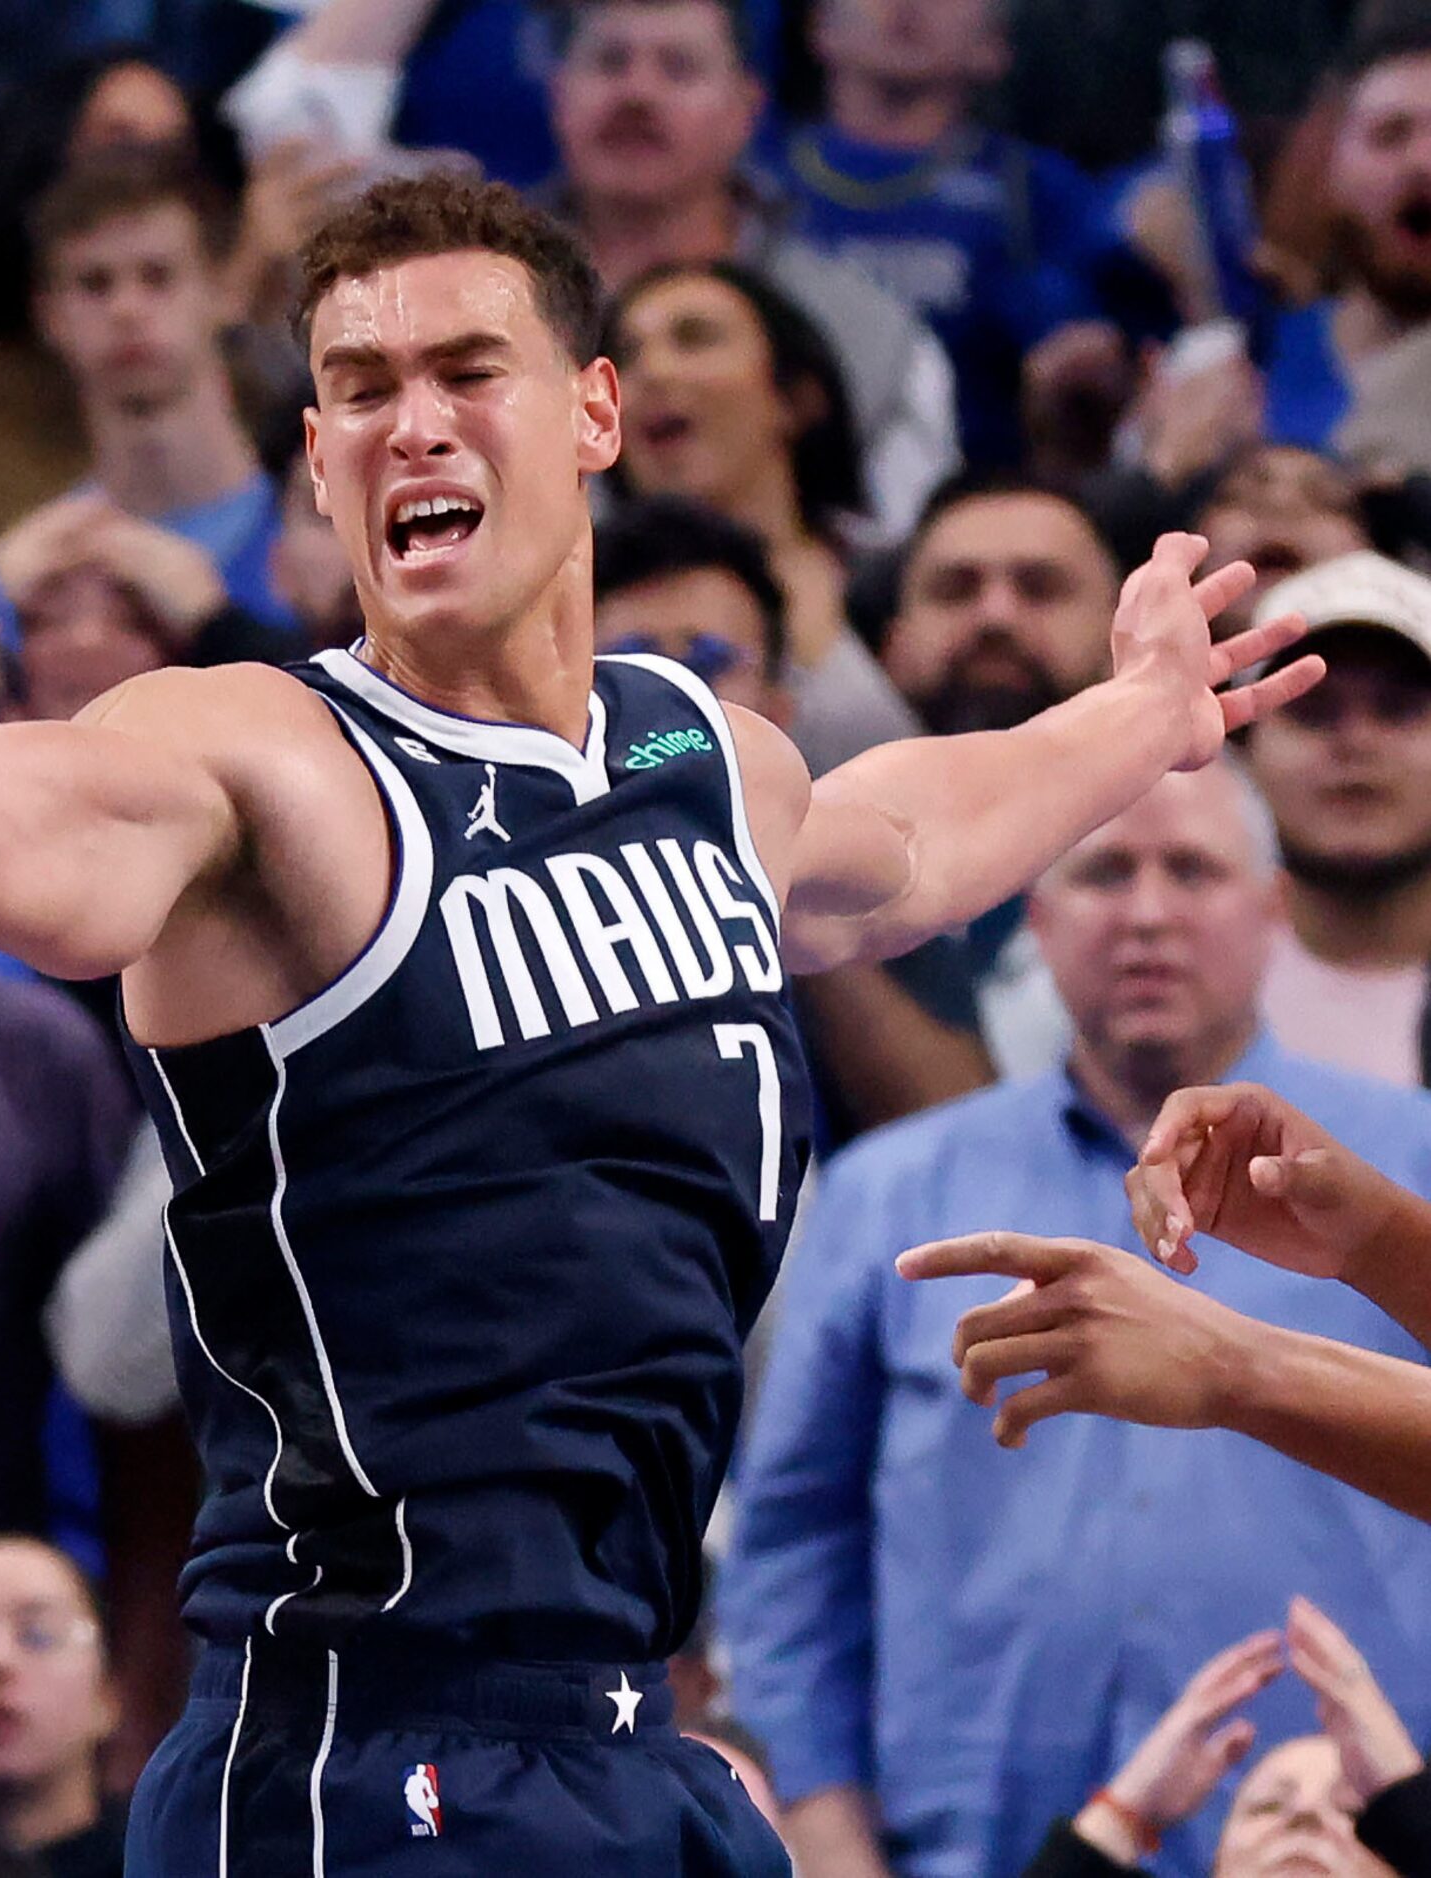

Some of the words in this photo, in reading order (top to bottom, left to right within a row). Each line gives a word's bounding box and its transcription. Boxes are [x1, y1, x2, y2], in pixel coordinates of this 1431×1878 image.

[624, 727, 712, 770] chime
[438, 838, 783, 1050] MAVS
[712, 1023, 781, 1220] 7
